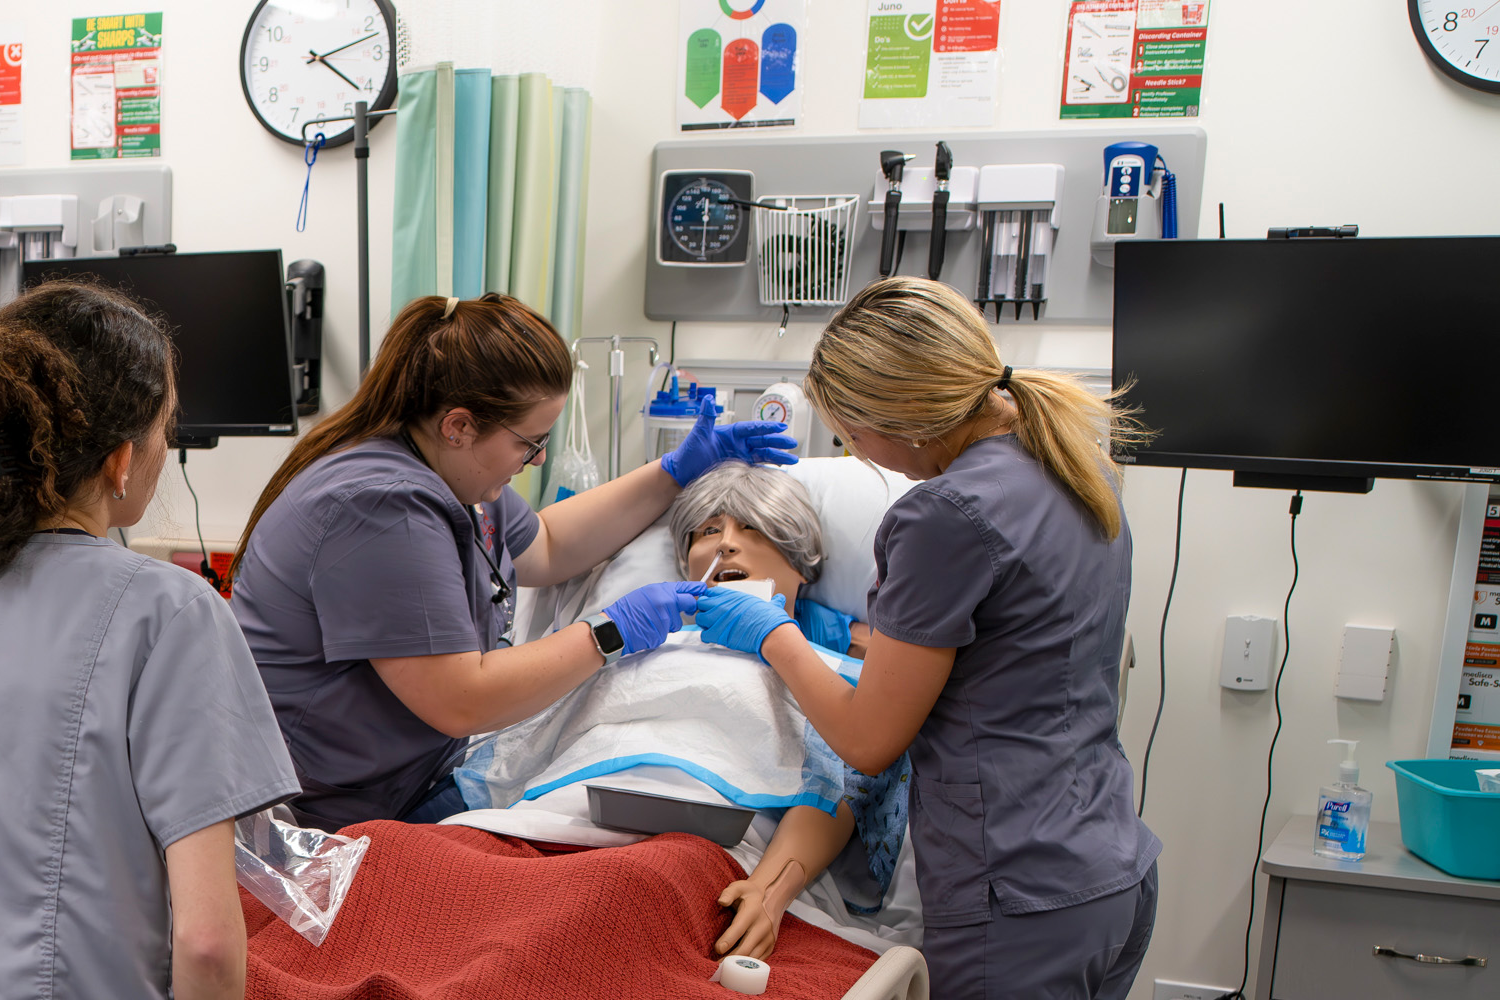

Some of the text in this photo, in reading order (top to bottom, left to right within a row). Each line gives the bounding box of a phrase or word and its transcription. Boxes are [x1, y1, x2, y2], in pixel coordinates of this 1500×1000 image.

[878, 2, 902, 11] Juno
[1461, 8, 1476, 18] 20
[86, 14, 145, 31] BE SMART WITH
[364, 16, 374, 32] 2
[1443, 11, 1458, 32] 8
[267, 26, 283, 42] 10
[1138, 31, 1202, 40] Discarding Container
[1486, 25, 1499, 36] 19
[98, 29, 135, 48] SHARPS
[372, 44, 383, 61] 3
[1139, 46, 1143, 55] 1
[1474, 38, 1490, 59] 7
[260, 56, 269, 72] 9
[364, 79, 373, 93] 4
[1167, 78, 1186, 86] Stick?
[269, 87, 278, 103] 8
[1135, 93, 1139, 102] 1
[290, 107, 300, 123] 7
[344, 102, 354, 117] 5
[1133, 107, 1139, 117] 2
[316, 113, 325, 129] 6
[1489, 506, 1498, 516] 5
[1480, 617, 1491, 626] M
[1327, 802, 1348, 812] Purell
